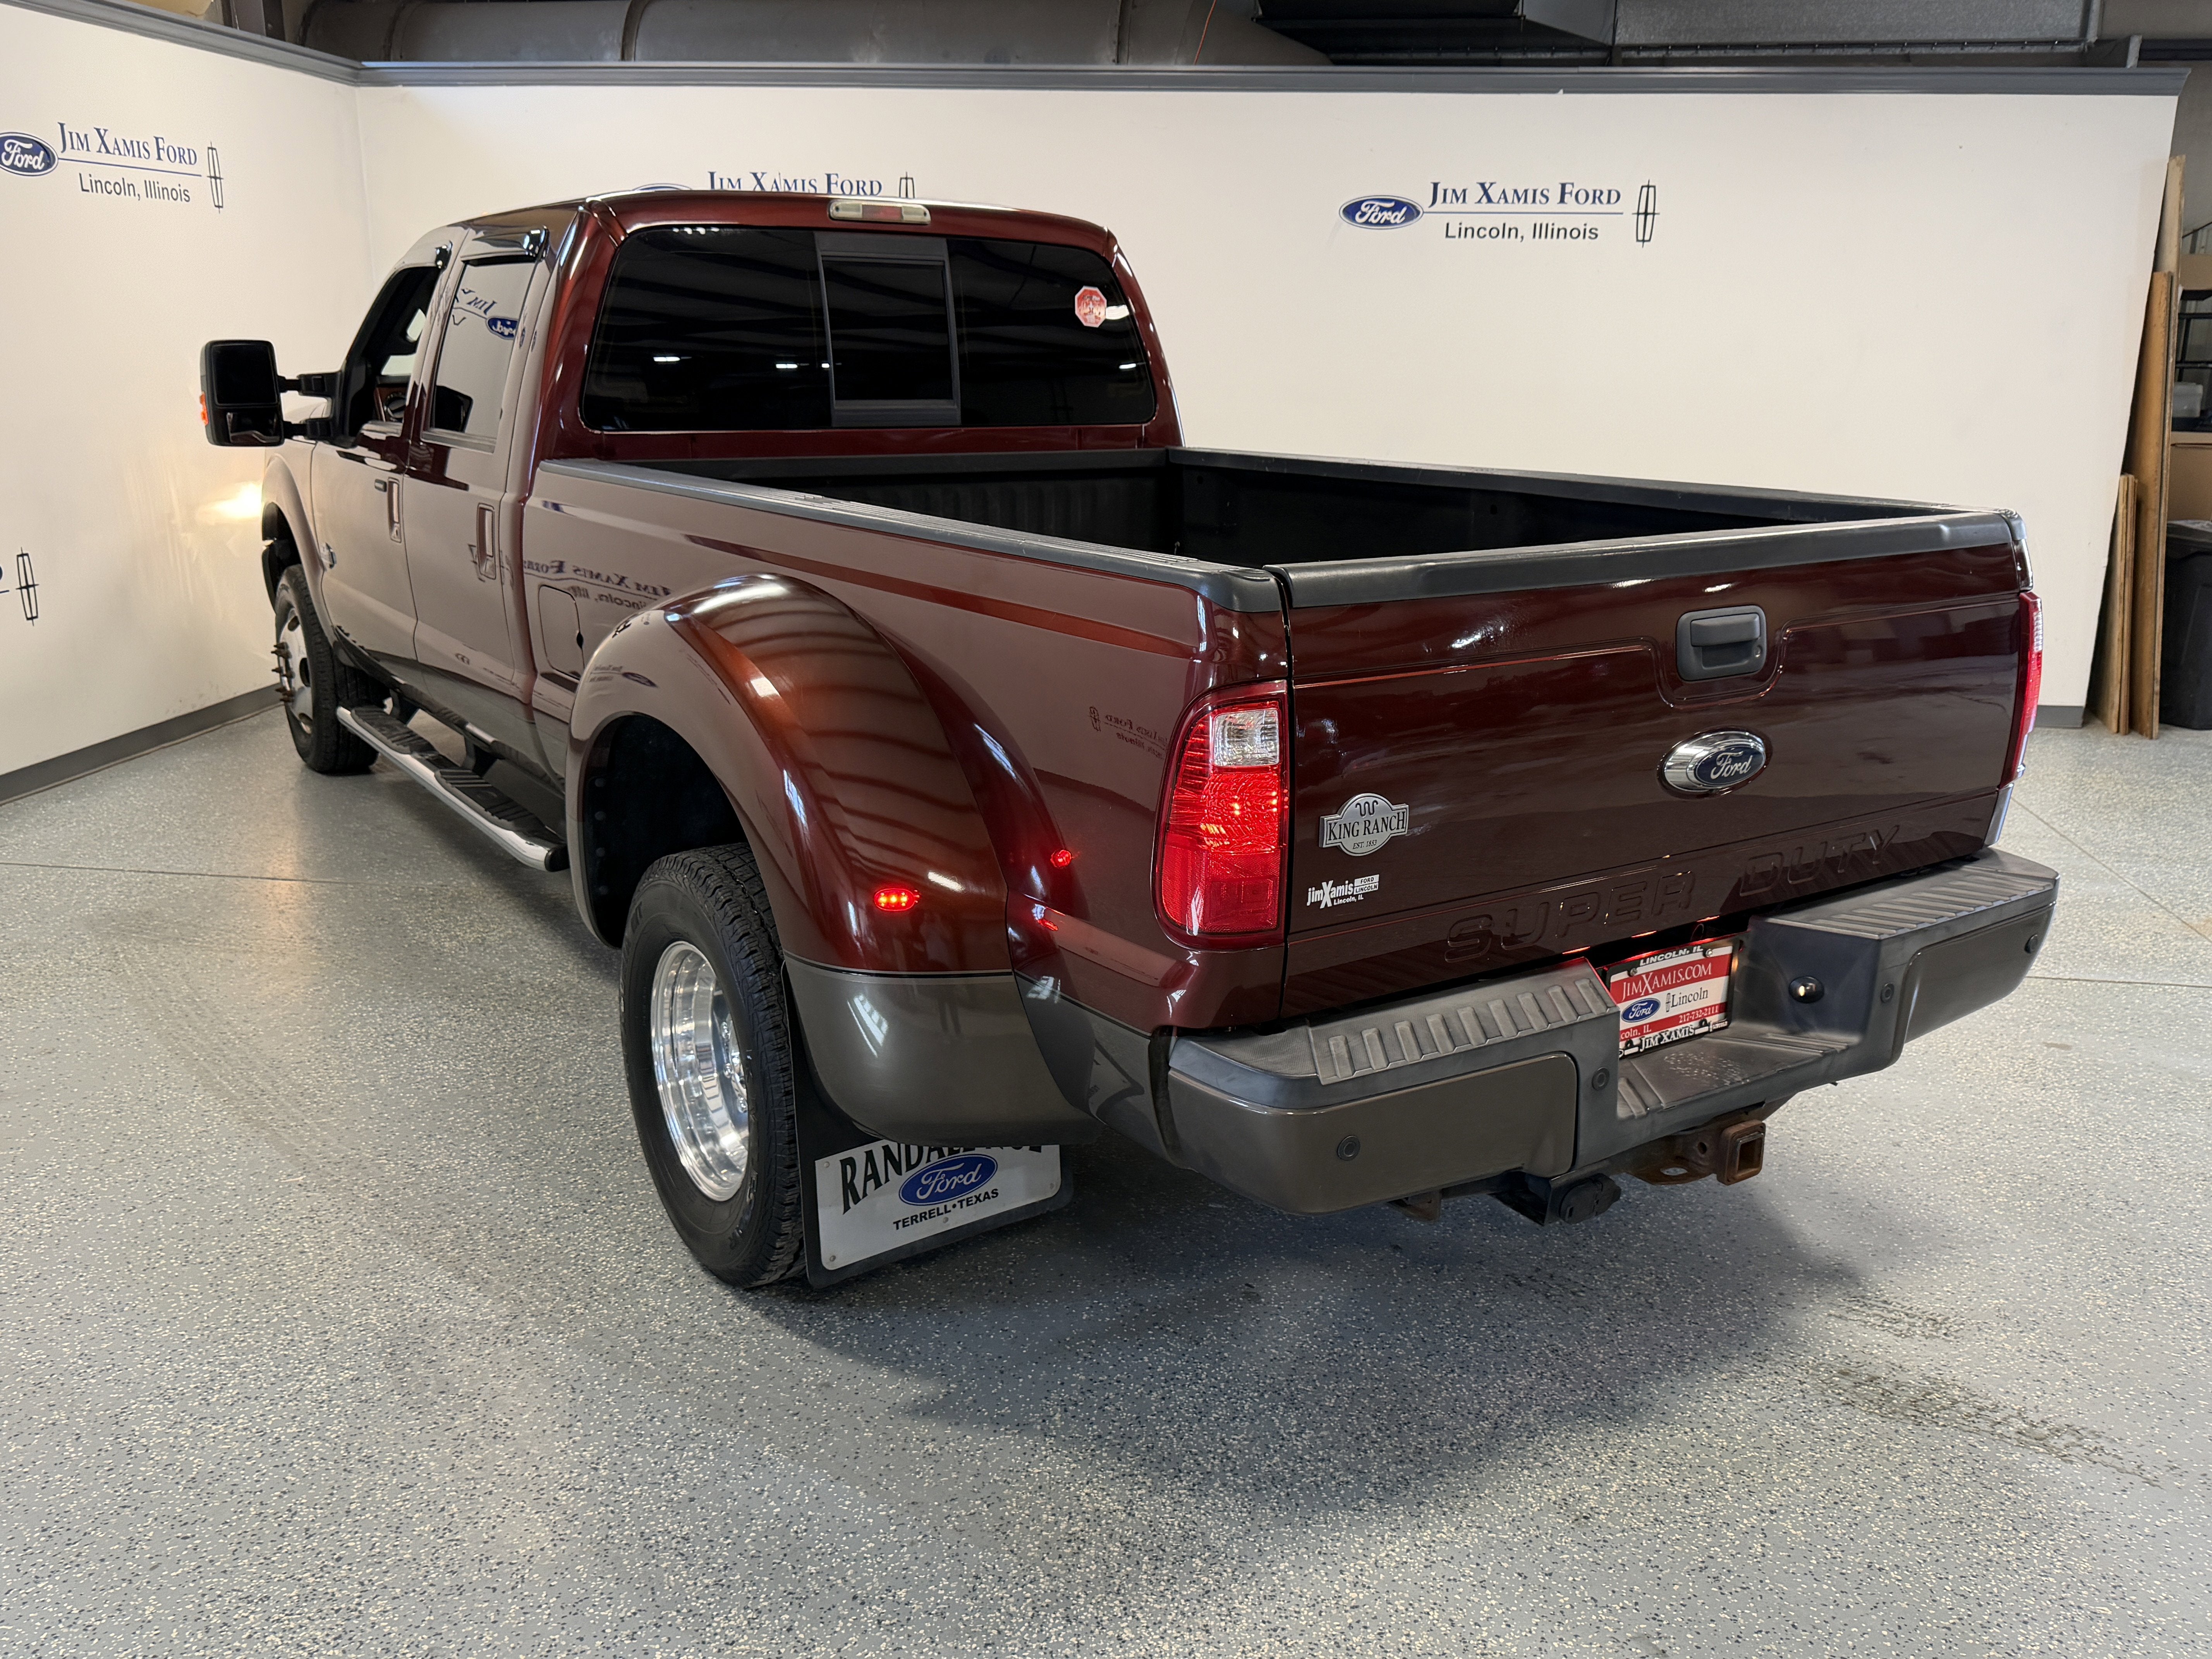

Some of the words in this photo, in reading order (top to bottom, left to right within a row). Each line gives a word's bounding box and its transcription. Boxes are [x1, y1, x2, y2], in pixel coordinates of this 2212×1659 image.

[1, 139, 45, 170] Ford
[57, 122, 91, 153] JIM
[93, 127, 151, 160] XAMIS
[153, 136, 198, 165] FORD
[79, 173, 141, 201] Lincoln,
[144, 180, 191, 202] Illinois
[824, 173, 883, 196] FORD
[1428, 181, 1468, 208] JIM
[1474, 181, 1550, 205] XAMIS
[1557, 182, 1621, 205] FORD
[1355, 201, 1407, 225] Ford
[1445, 222, 1524, 242] Lincoln,
[1532, 222, 1599, 240] Illinois
[1710, 751, 1753, 780] Ford
[1328, 821, 1359, 841] KING
[1363, 811, 1406, 835] RANCH
[1333, 895, 1357, 905] Lincoln,
[1355, 884, 1377, 893] LINCOLN
[1444, 871, 1696, 963] SUPER
[1739, 824, 1900, 897] DUTY
[1671, 987, 1709, 1008] Lincoln
[1629, 1003, 1652, 1019] Ford
[1679, 1006, 1719, 1023] 217-732-2111
[1640, 1037, 1659, 1052] JIM
[1660, 1026, 1695, 1044] XAMIS
[1643, 1024, 1652, 1033] IL
[916, 1163, 982, 1200] Ford
